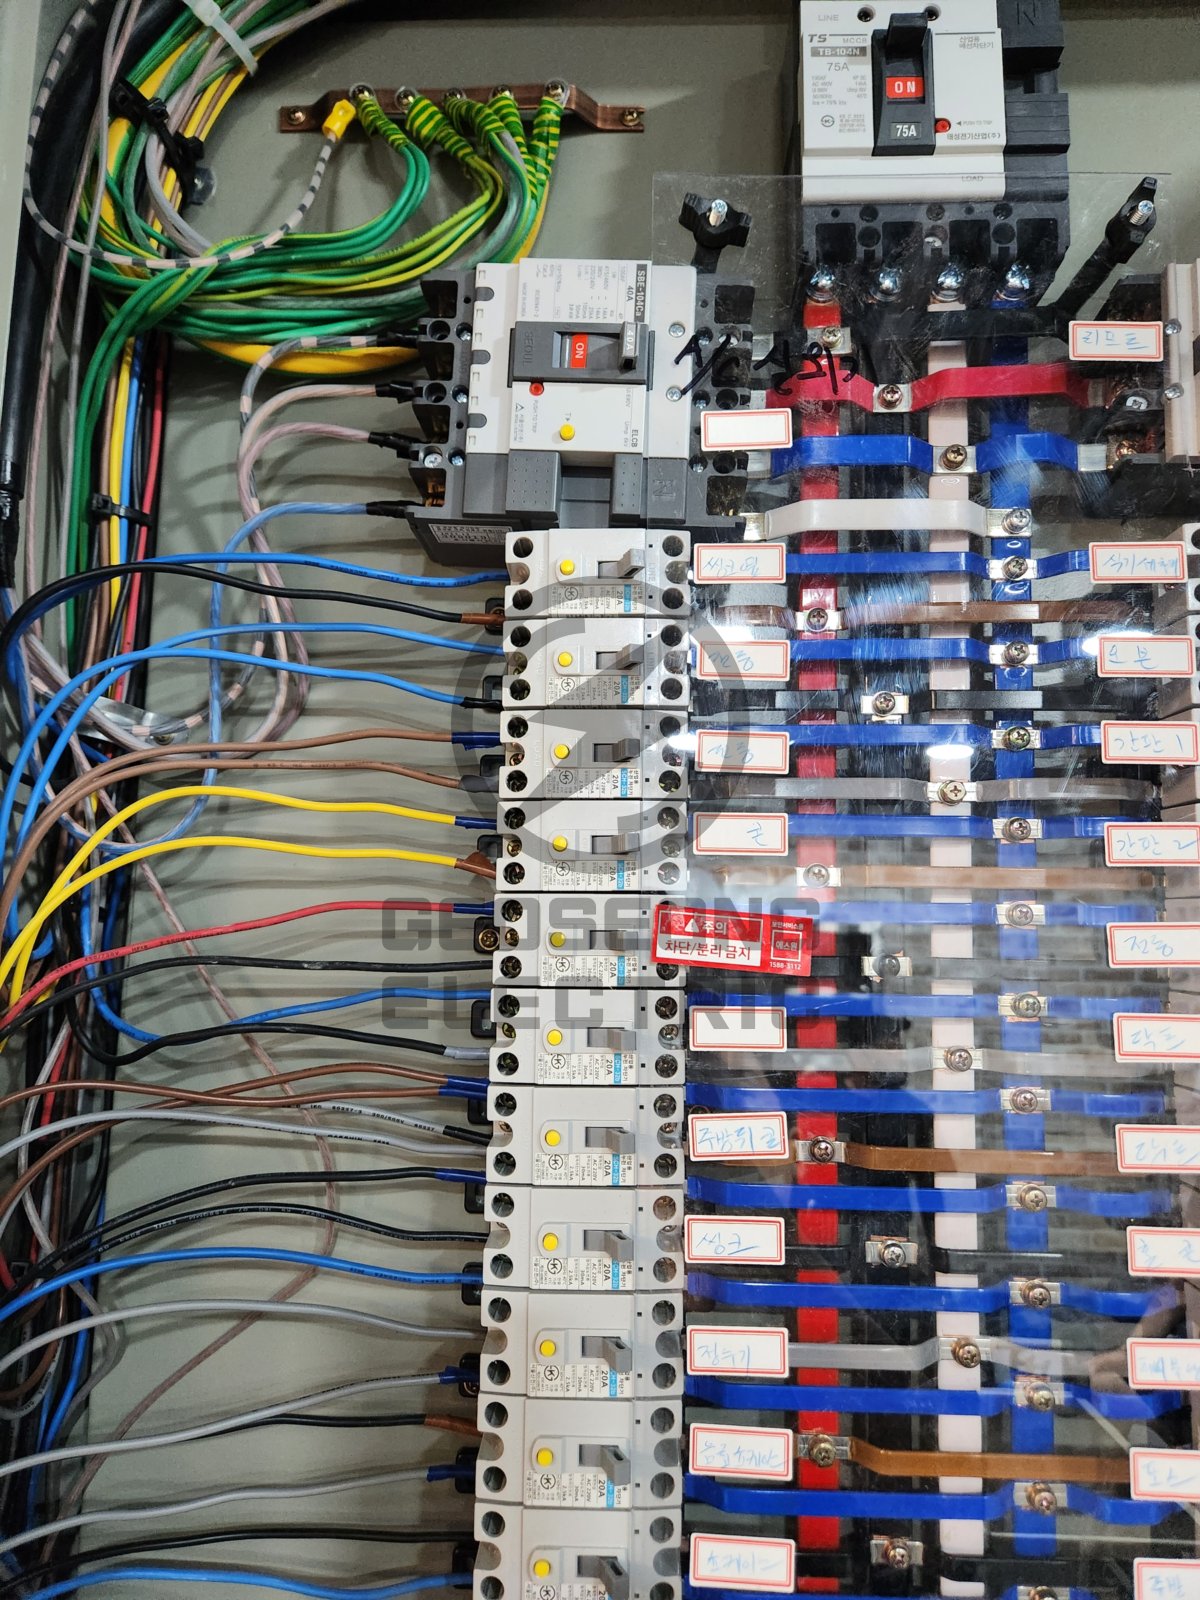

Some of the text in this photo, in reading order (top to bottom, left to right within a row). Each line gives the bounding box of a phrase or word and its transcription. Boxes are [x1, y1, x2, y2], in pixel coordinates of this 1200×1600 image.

[808, 34, 827, 43] TS
[818, 48, 859, 56] TB-104N
[827, 62, 849, 72] 75A
[894, 81, 916, 93] ON
[896, 124, 916, 137] 75A
[626, 285, 634, 301] 40A
[635, 270, 646, 317] SBE-104Ca
[575, 342, 584, 359] ON
[631, 429, 639, 448] ELCB
[616, 590, 624, 606] 20A
[613, 681, 621, 696] 20A
[1114, 730, 1164, 753] 간판
[1116, 831, 1163, 858] 간판
[702, 920, 727, 935] 주의
[665, 940, 751, 961] 차단/분리 금지
[775, 941, 798, 951] 에스원
[609, 962, 617, 978] 20A
[769, 961, 802, 970] 1588-3112
[605, 1059, 613, 1076] 20A
[603, 1160, 611, 1177] 20A
[603, 1264, 611, 1281] 20A
[601, 1370, 609, 1388] 20A
[598, 1479, 606, 1498] 20A
